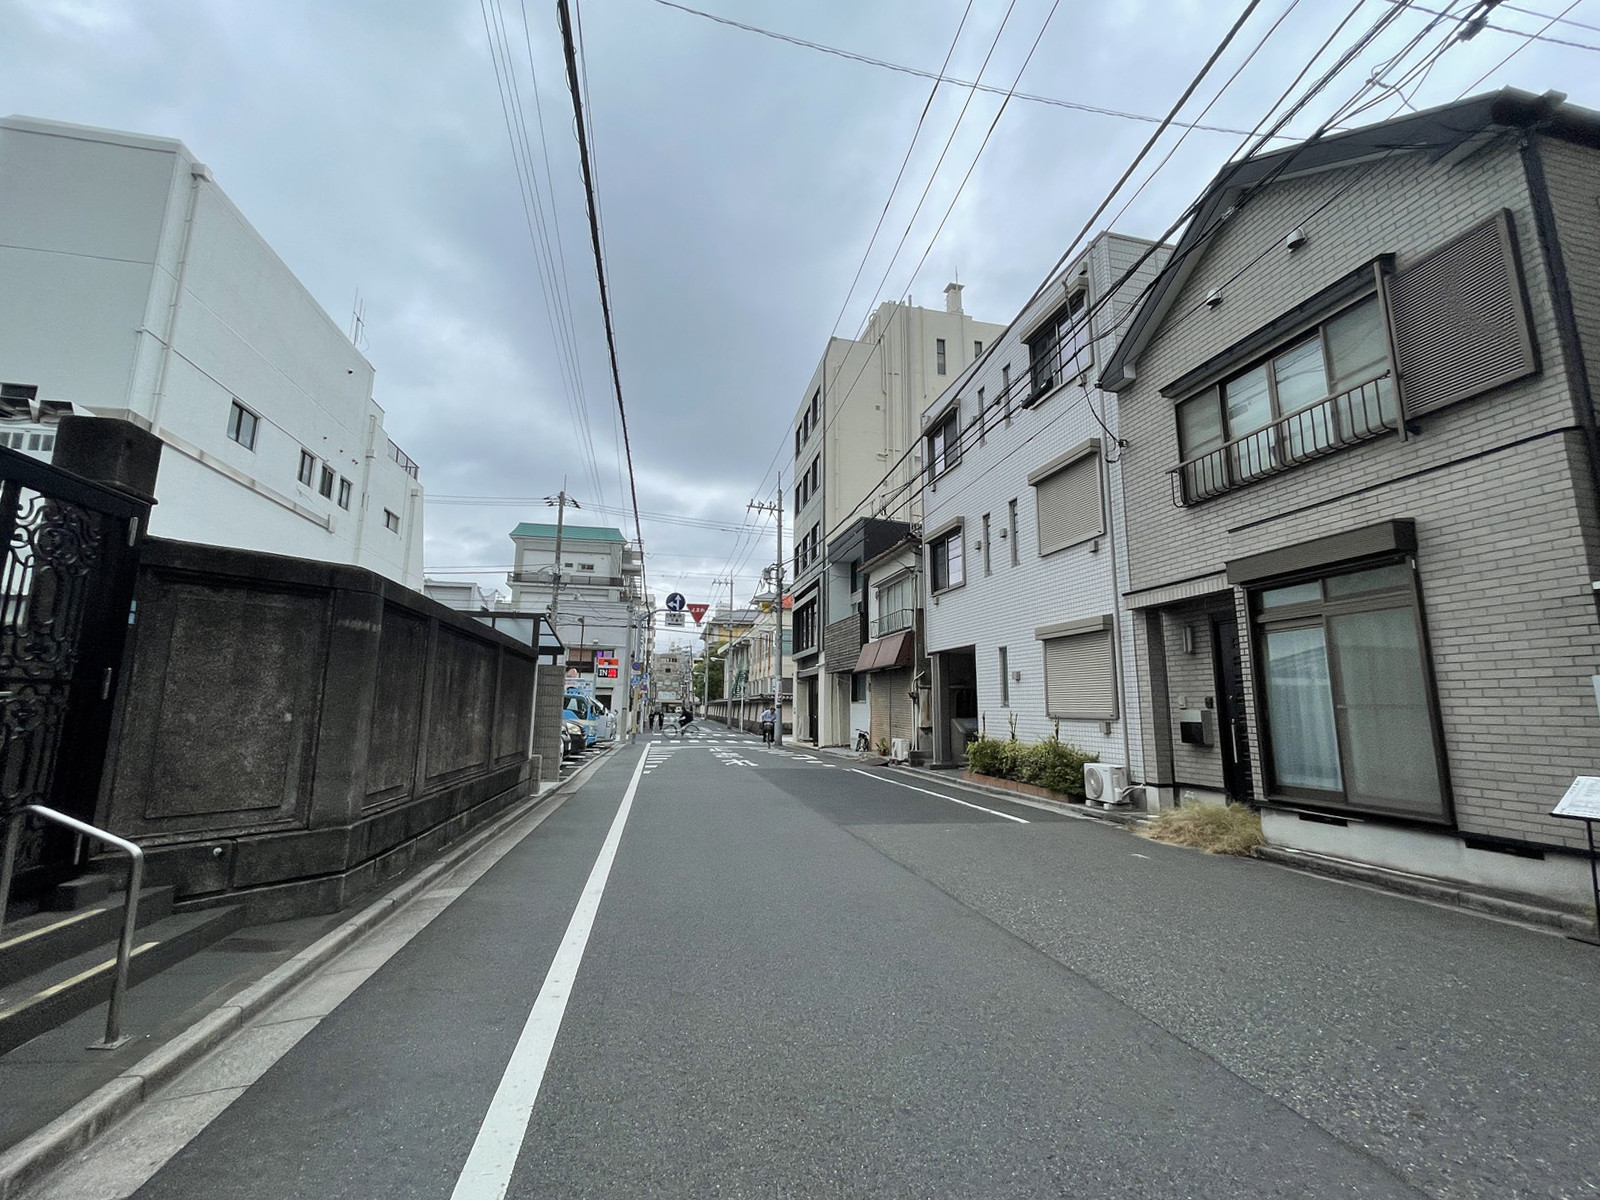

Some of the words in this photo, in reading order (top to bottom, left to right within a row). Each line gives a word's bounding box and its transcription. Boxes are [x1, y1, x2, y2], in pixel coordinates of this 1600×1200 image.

[599, 669, 608, 677] IN
[709, 746, 759, 766] 止まれ
